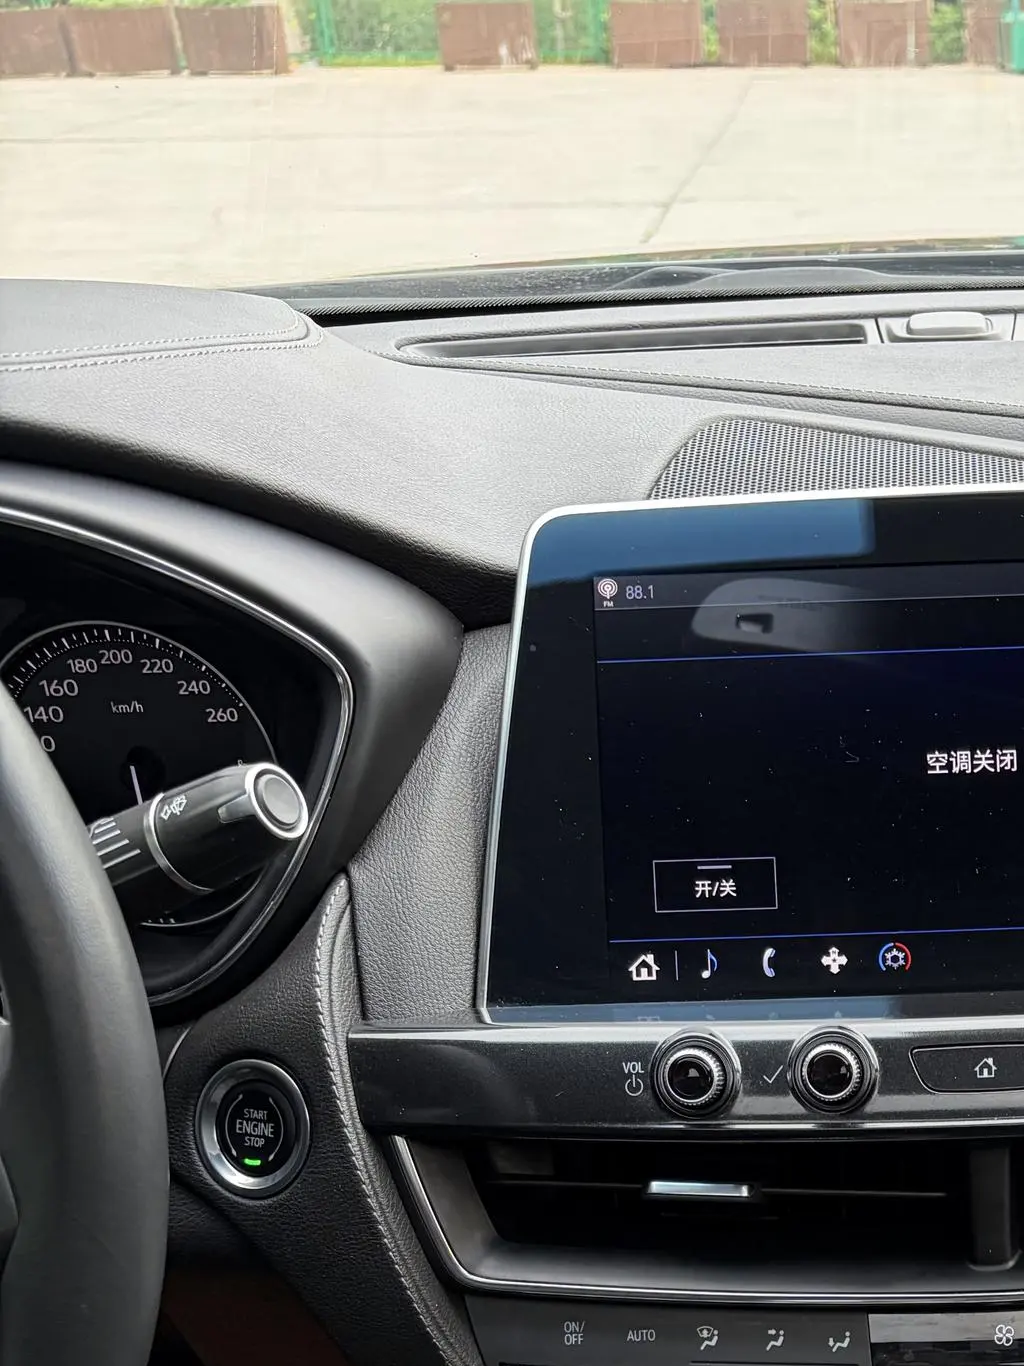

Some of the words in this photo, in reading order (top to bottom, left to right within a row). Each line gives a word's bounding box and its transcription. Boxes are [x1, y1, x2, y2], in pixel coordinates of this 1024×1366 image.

[625, 584, 654, 600] 88.1
[99, 649, 133, 665] 200
[66, 658, 98, 674] 180
[140, 658, 174, 674] 220
[39, 679, 79, 697] 160
[177, 680, 211, 695] 240
[23, 705, 64, 723] 140
[110, 700, 144, 713] km/h
[206, 707, 239, 723] 260
[926, 748, 1018, 774] 空调关闭
[694, 878, 737, 898] 开/关
[622, 1061, 645, 1075] VOL
[243, 1108, 269, 1121] START
[235, 1119, 275, 1138] ENGINE
[244, 1136, 265, 1148] STOP
[564, 1333, 584, 1346] OFF
[626, 1329, 656, 1342] AUTO
